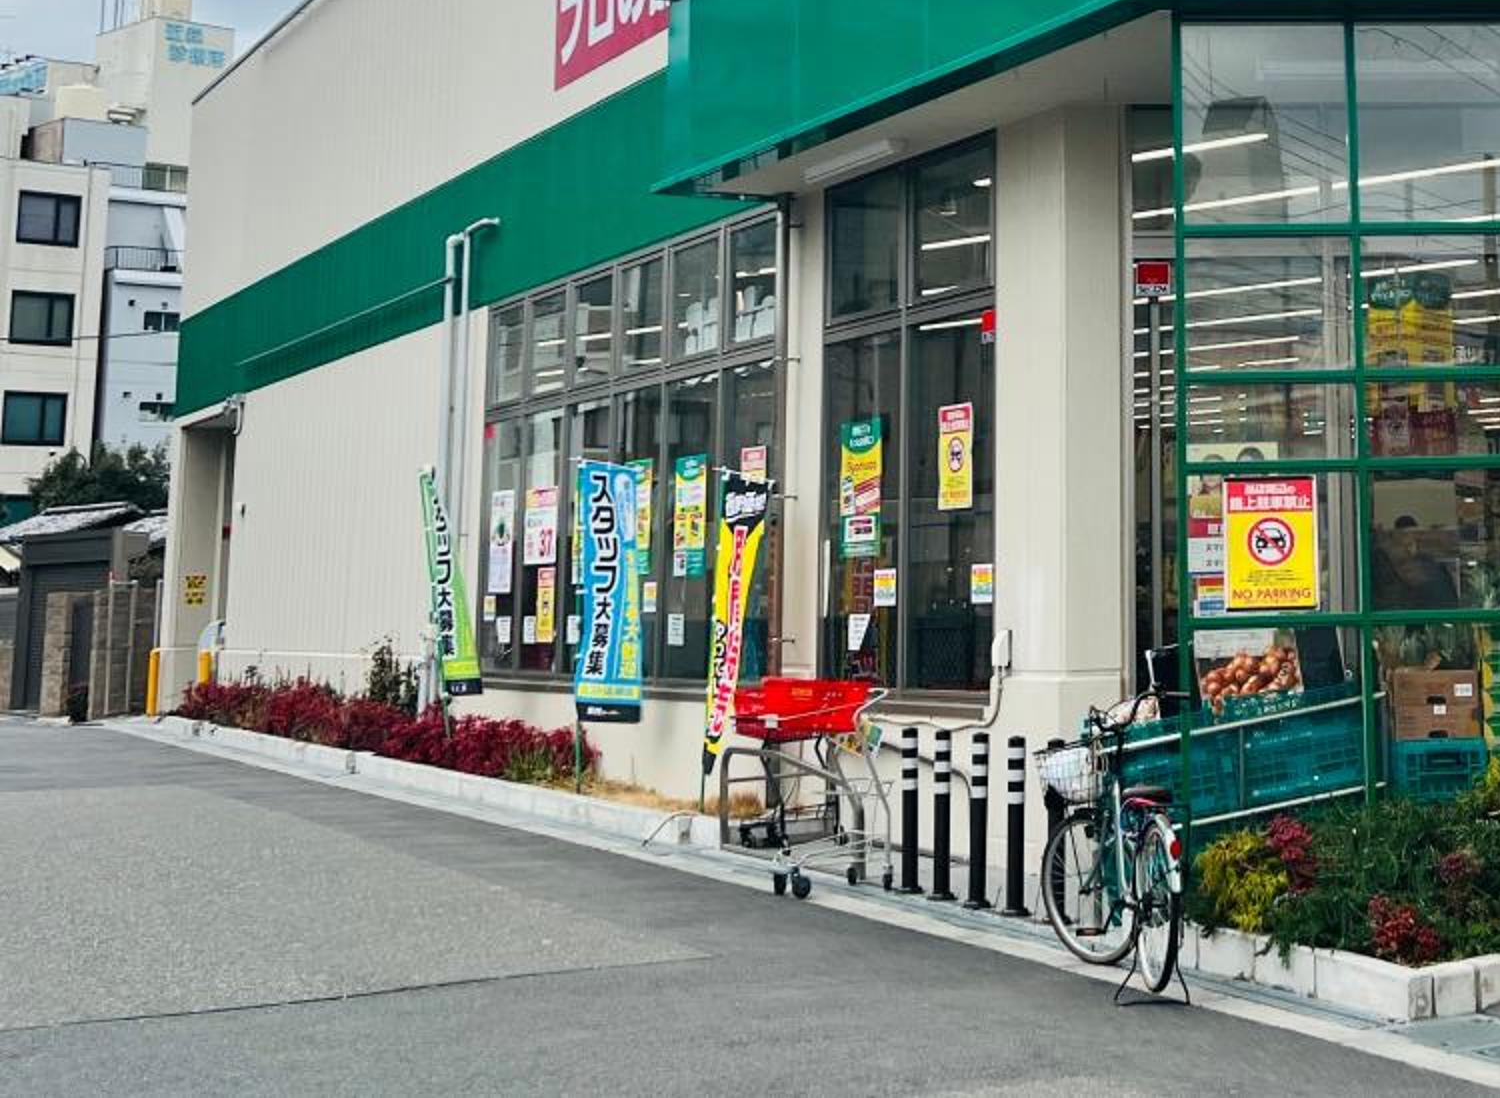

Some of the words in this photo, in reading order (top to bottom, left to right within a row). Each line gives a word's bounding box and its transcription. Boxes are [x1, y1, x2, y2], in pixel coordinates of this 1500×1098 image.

[586, 473, 618, 676] スタッフ大募集
[1232, 589, 1253, 600] NO
[1259, 588, 1312, 600] PARKING
